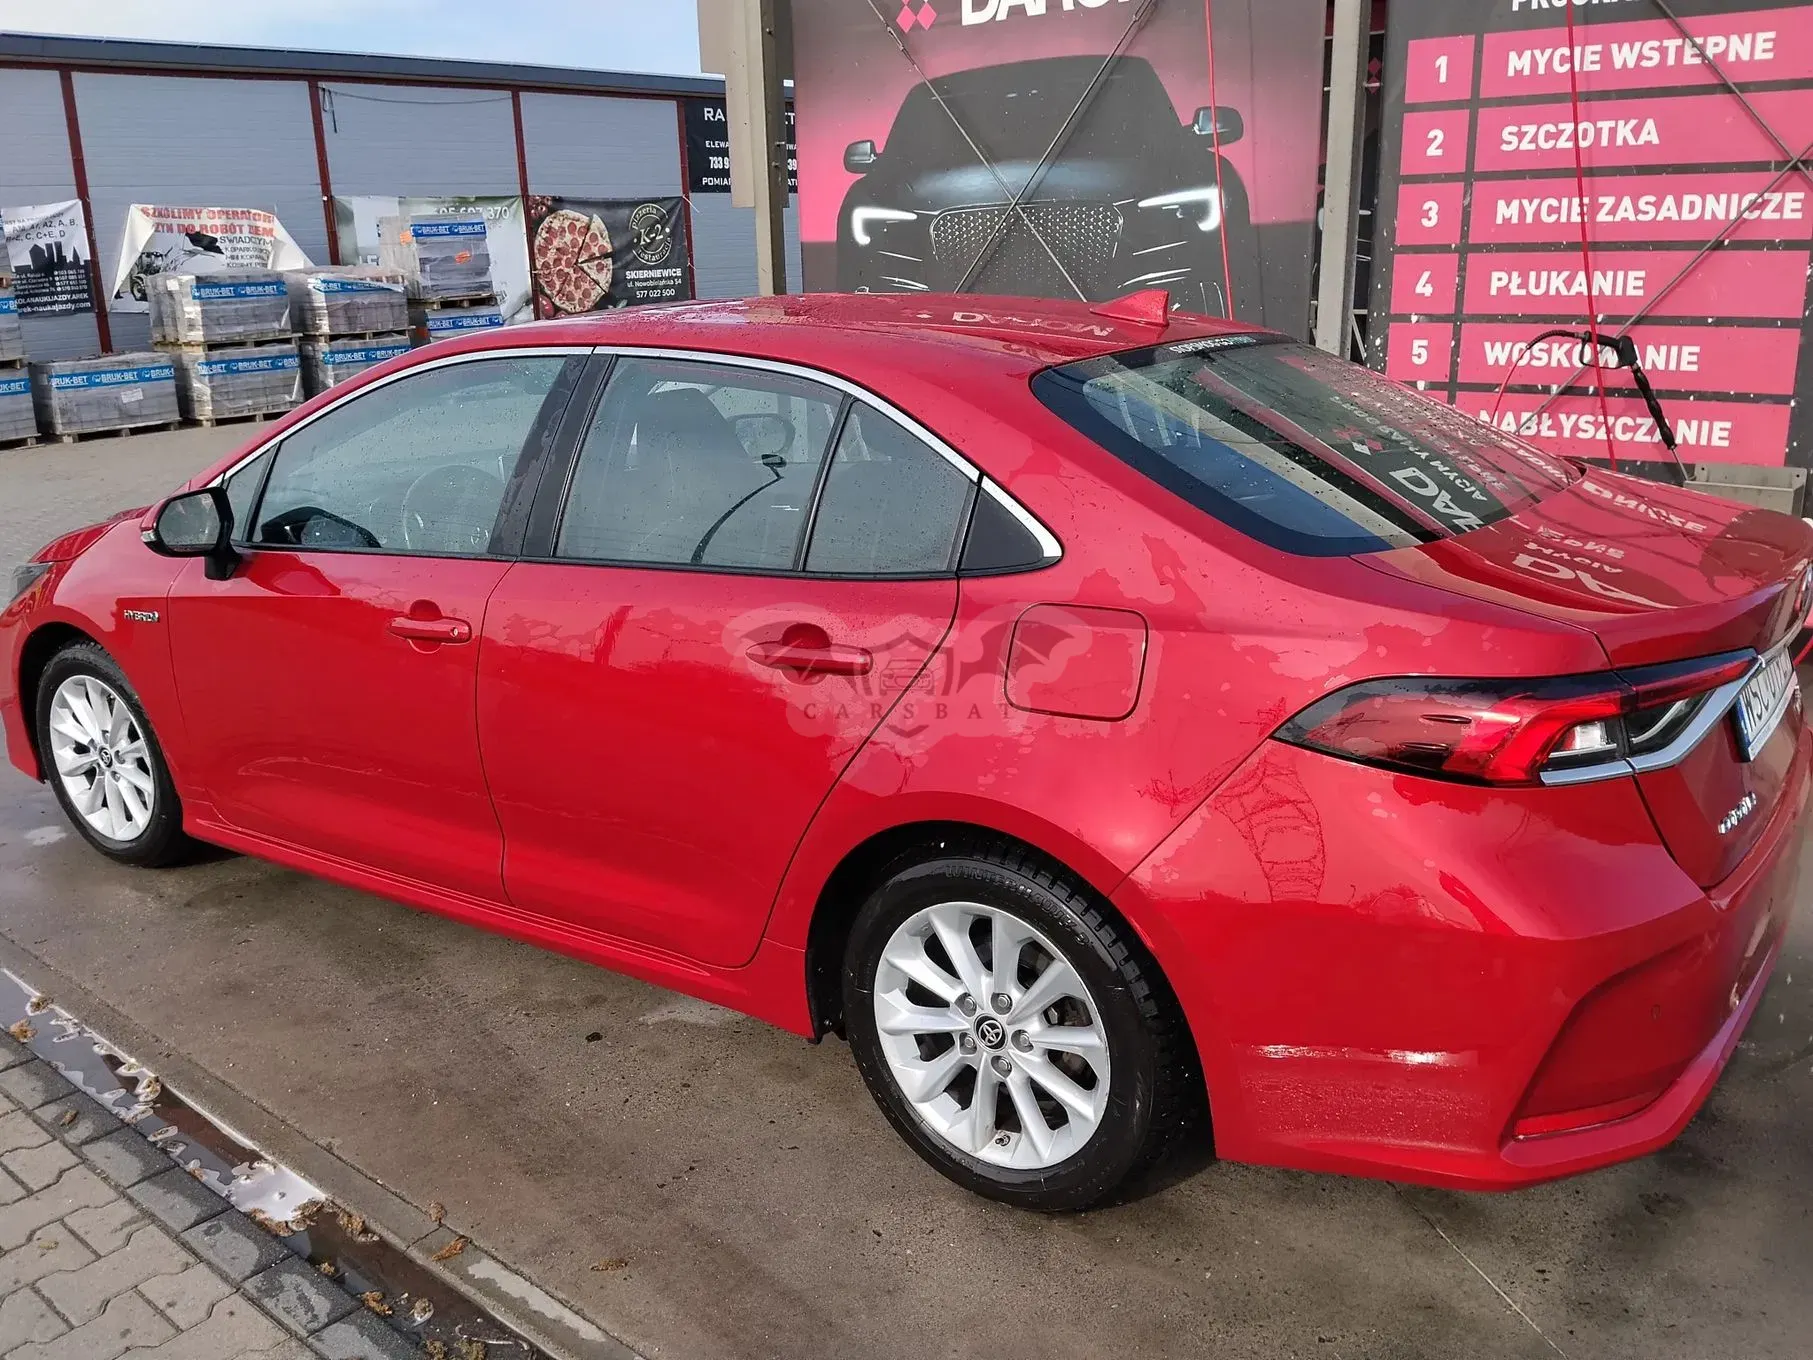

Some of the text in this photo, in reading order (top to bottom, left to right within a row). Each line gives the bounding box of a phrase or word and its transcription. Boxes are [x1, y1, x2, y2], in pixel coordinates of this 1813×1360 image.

[1434, 55, 1449, 83] 1
[1507, 44, 1603, 77] MYCIE
[705, 140, 730, 148] ELEWA
[1425, 128, 1445, 157] 2
[1500, 118, 1660, 152] SZCZOTKA
[206, 207, 275, 223] OPERATOR
[1420, 200, 1439, 228] 3
[1495, 192, 1805, 225] MYCIE ZASADNICZE
[625, 268, 682, 280] SKIERNIEWICE
[1415, 271, 1433, 297] 4
[1489, 270, 1646, 296] PŁUKANIE
[200, 285, 279, 297] BRUK-BET BRUK-BET
[334, 352, 366, 363] BRUK-BET
[1411, 339, 1428, 364] 5
[1484, 341, 1700, 372] WOSKOWNIE
[101, 371, 139, 382] BRUK-BET
[238, 360, 273, 371] BRUK-BET
[1479, 410, 1732, 447] NABŁYSZCZNIE
